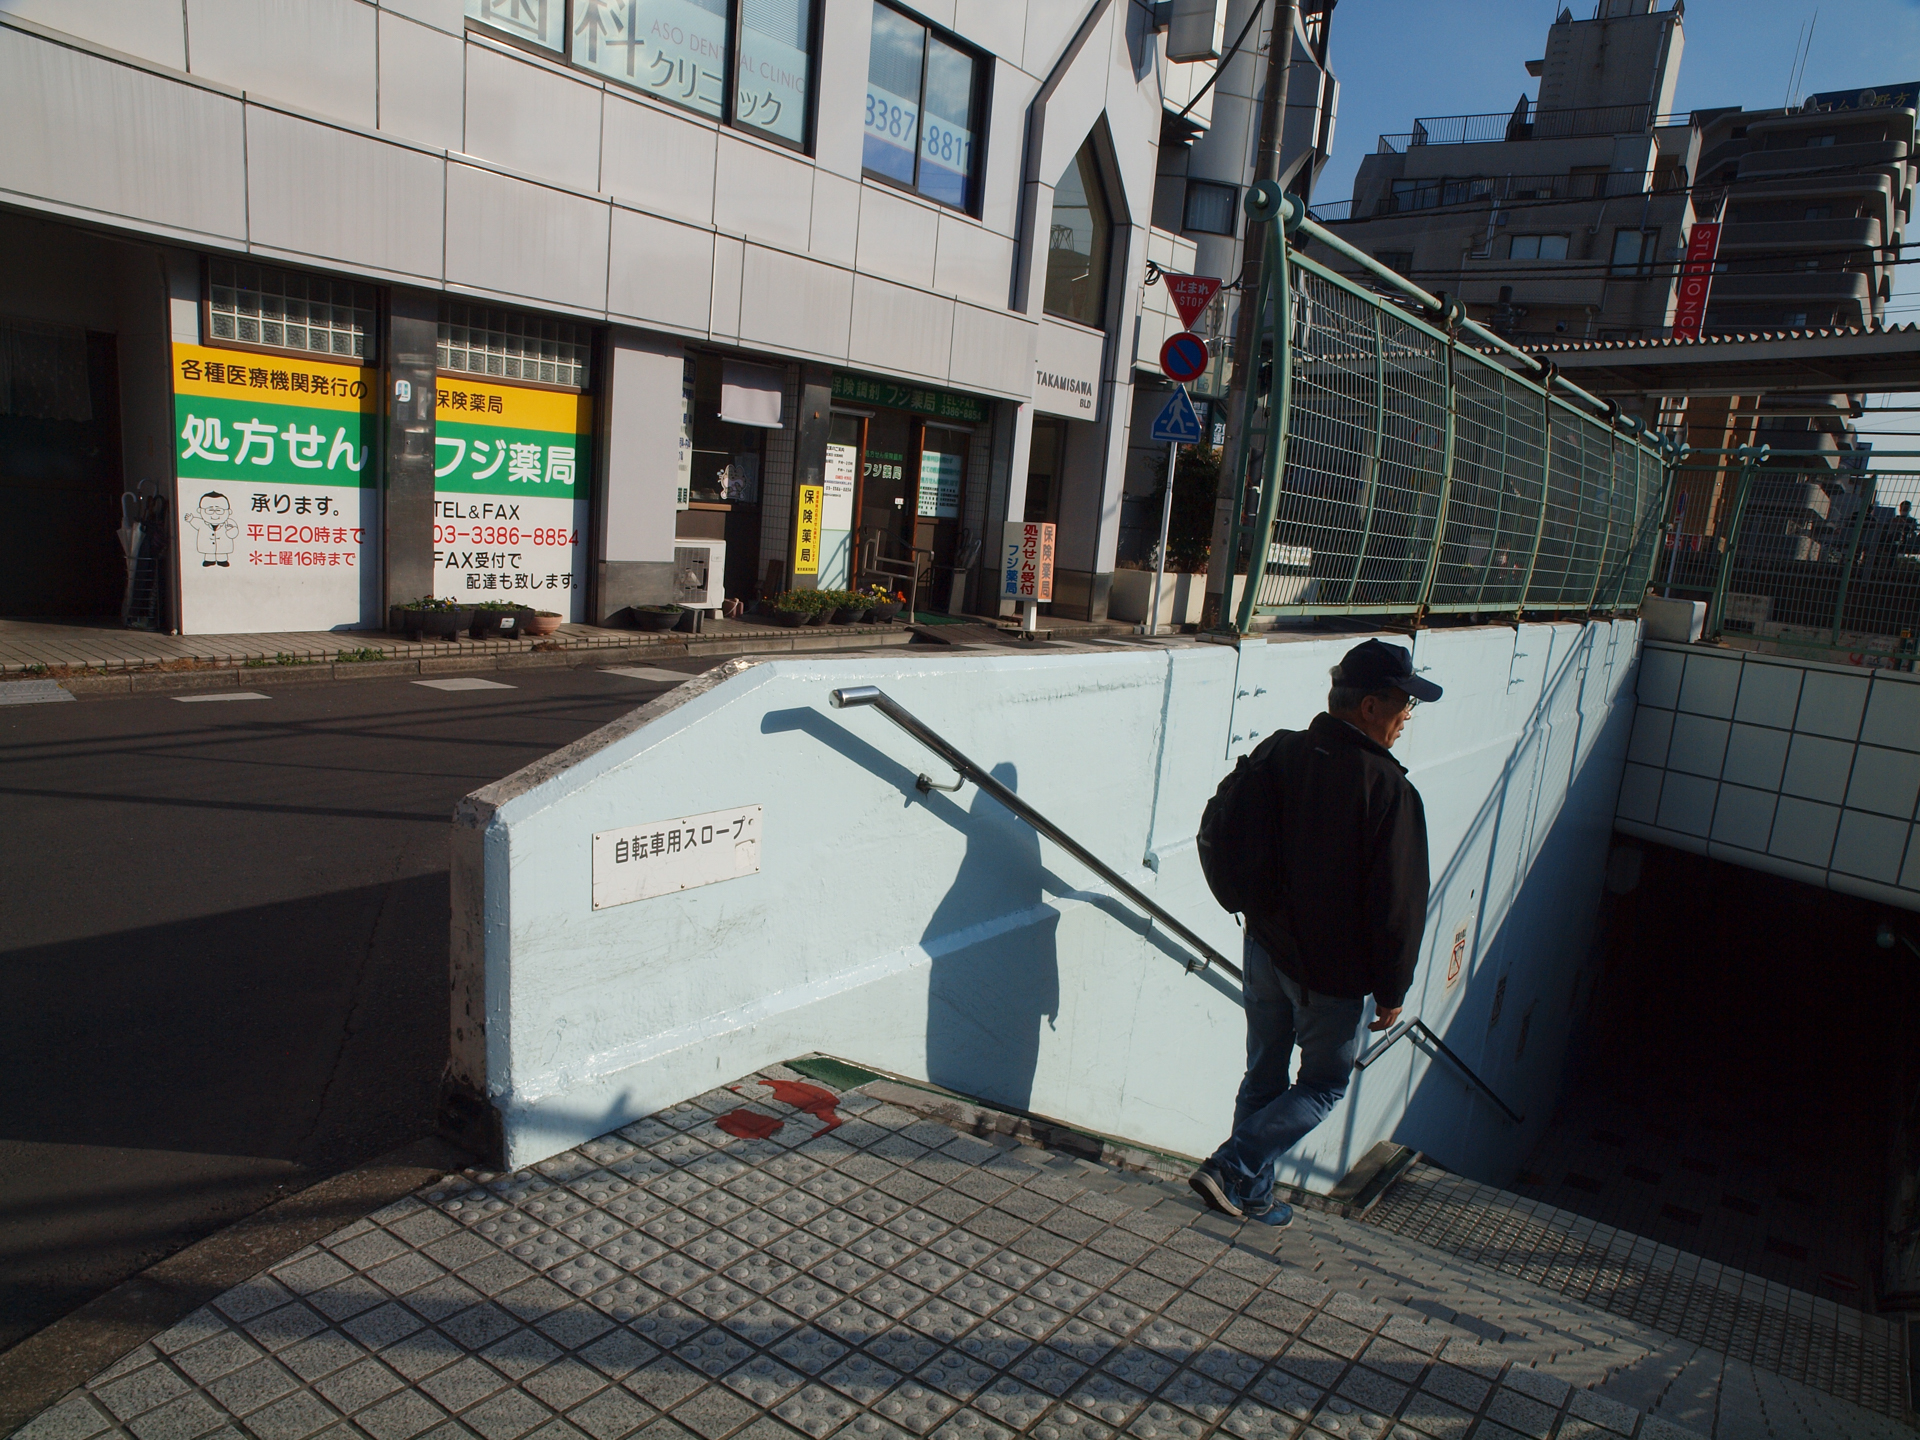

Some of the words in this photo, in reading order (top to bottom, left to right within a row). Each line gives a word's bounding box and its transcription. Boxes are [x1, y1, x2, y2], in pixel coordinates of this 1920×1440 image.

[651, 19, 684, 44] ASO
[760, 62, 805, 93] CLINIC
[650, 50, 782, 125] クリニック
[1174, 281, 1209, 295] 止まれ
[1180, 296, 1203, 307] STOP
[181, 360, 368, 399] 各種医療機関発行の
[832, 376, 880, 400] 保険調剤
[887, 384, 936, 411] フジ薬局
[1037, 371, 1092, 396] TAKAMISAWA
[435, 389, 503, 414] 保険薬局
[1080, 399, 1091, 409] BLD
[181, 414, 368, 471] 処方せん
[435, 437, 576, 485] フジ薬局
[863, 463, 903, 480] フジ薬局
[251, 493, 339, 516] 承ります。
[247, 524, 366, 544] 平日20時まで
[434, 525, 579, 546] 03-3386-8854
[801, 490, 814, 562] 保険薬局
[1005, 545, 1019, 594] フジ薬局
[1020, 525, 1038, 595] 処方せん受付
[1041, 526, 1053, 597] 保険薬局
[466, 572, 578, 589] 配達も致します。
[615, 815, 746, 864] 自転車用スロープ
